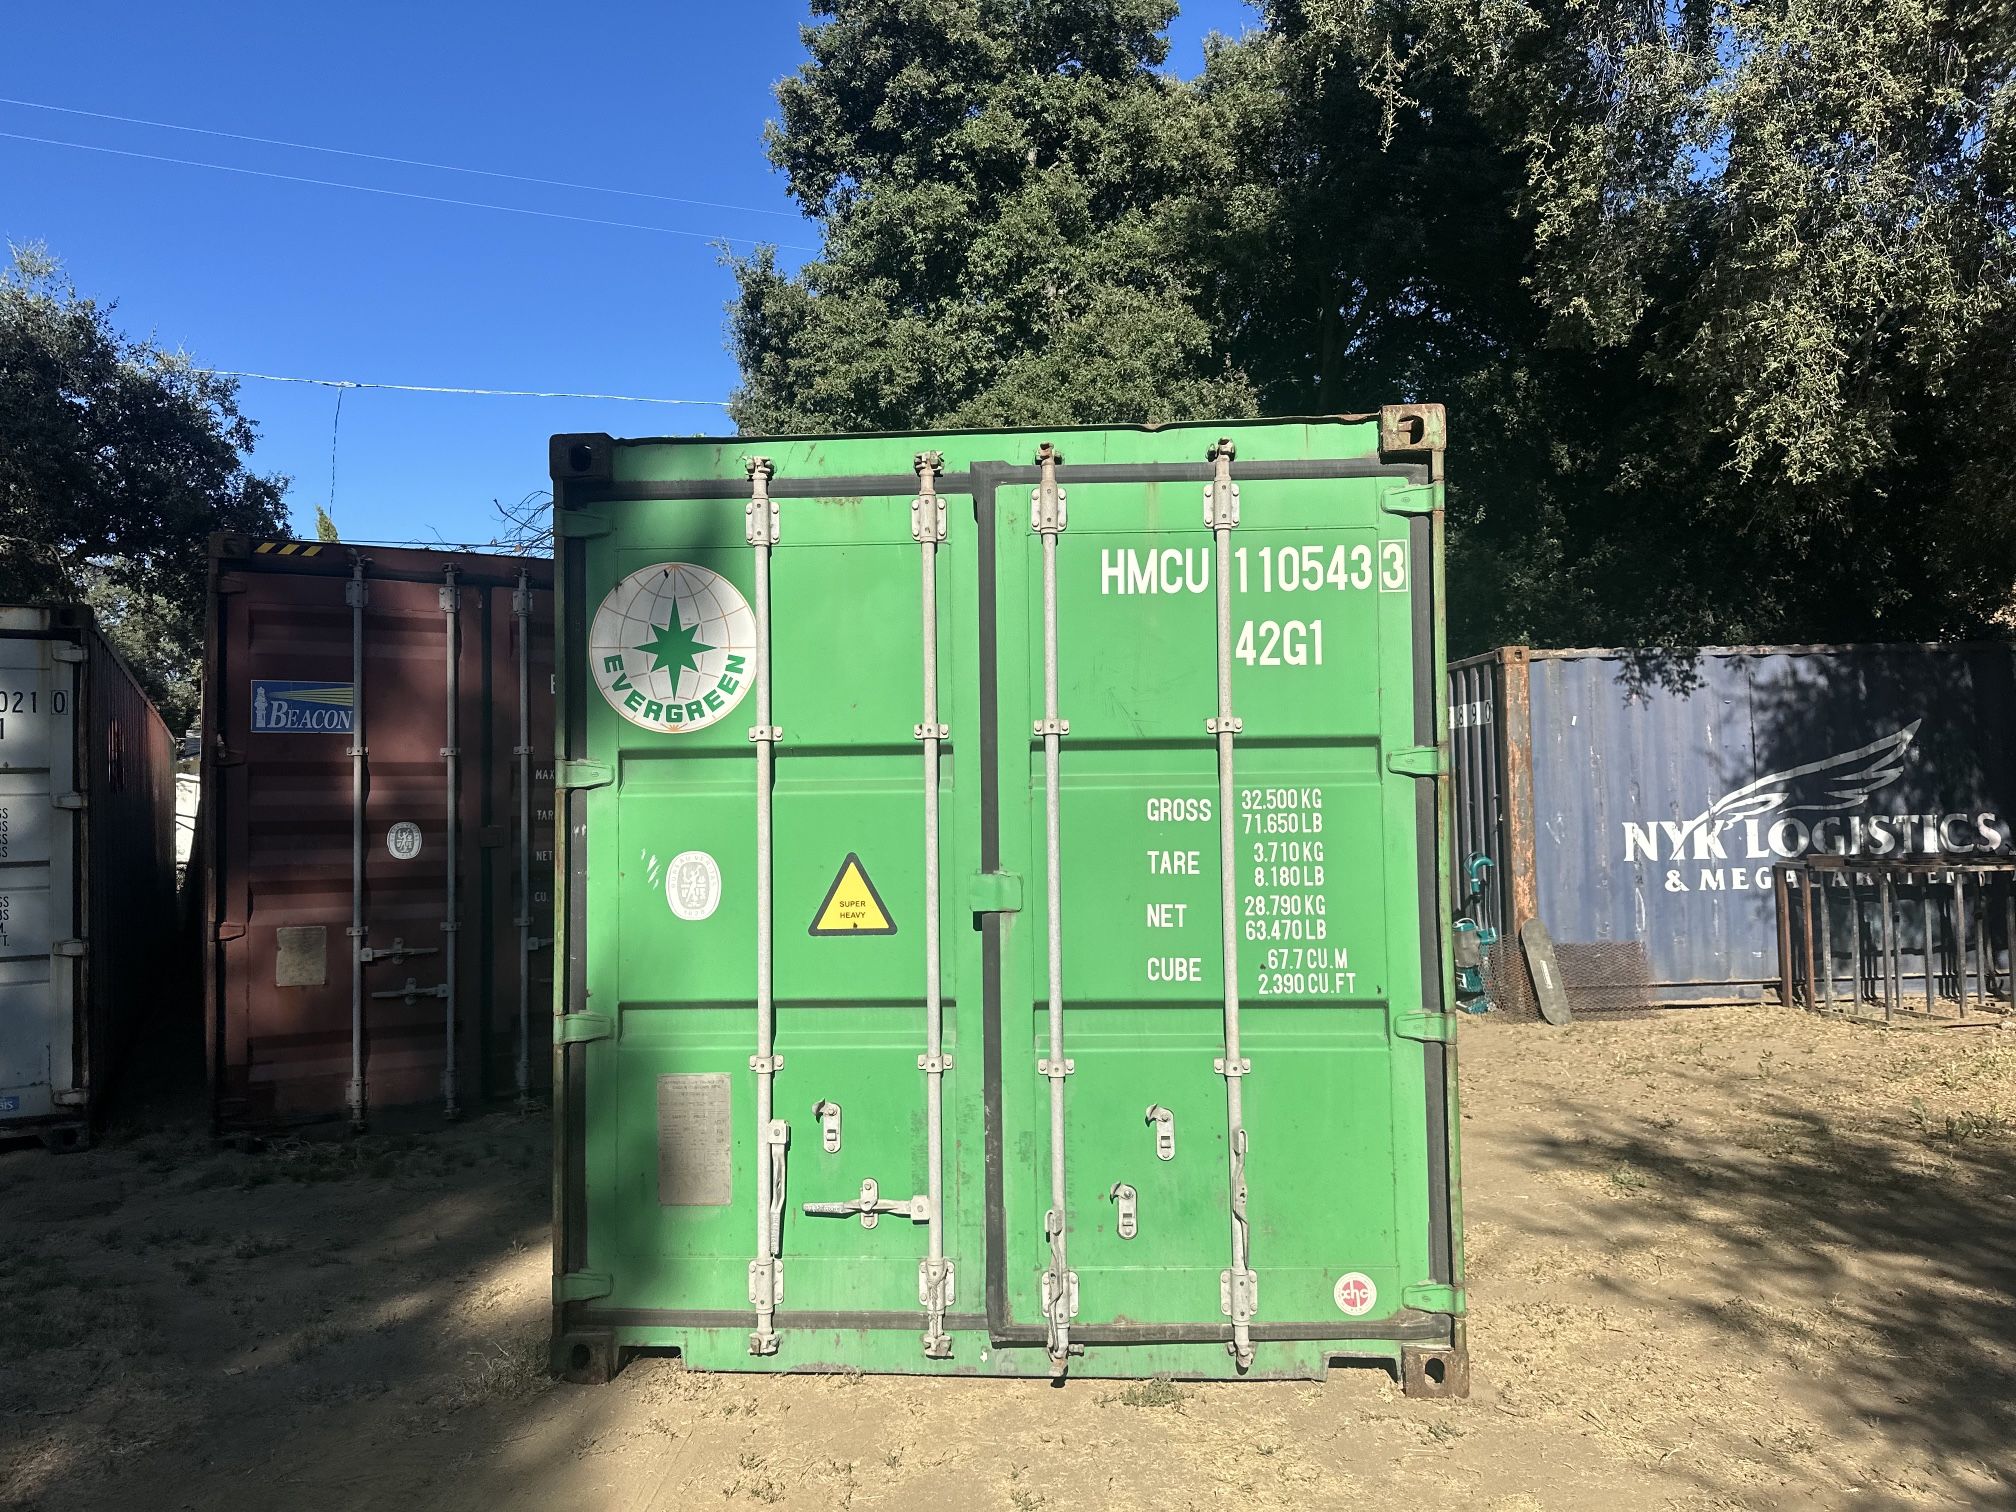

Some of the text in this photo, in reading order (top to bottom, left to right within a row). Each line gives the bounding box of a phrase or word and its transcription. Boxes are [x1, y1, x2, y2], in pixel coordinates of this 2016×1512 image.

[1101, 543, 1405, 595] HMCU 110543 3
[1235, 619, 1323, 666] 42G1
[603, 654, 746, 723] EVERGREEN
[1241, 788, 1322, 809] 32.500 KG
[536, 810, 555, 821] TAR
[1147, 798, 1212, 822] GROSS
[1243, 813, 1323, 834] 71.650 LB
[1622, 813, 2002, 861] NYK LOGISTICS
[1253, 841, 1324, 862] 3.710 KG
[1147, 851, 1200, 875] TARE
[1254, 866, 1325, 887] 8.180 LB
[1664, 869, 1690, 892] &
[839, 900, 866, 908] SUPER
[840, 911, 866, 919] HEAVY
[1244, 894, 1326, 916] 28.790 KG
[1147, 904, 1187, 928] NET
[1245, 919, 1327, 941] 63.470 LB
[1147, 957, 1202, 981] CUBE
[1267, 948, 1303, 970] 67.7
[1258, 973, 1305, 995] 2.390
